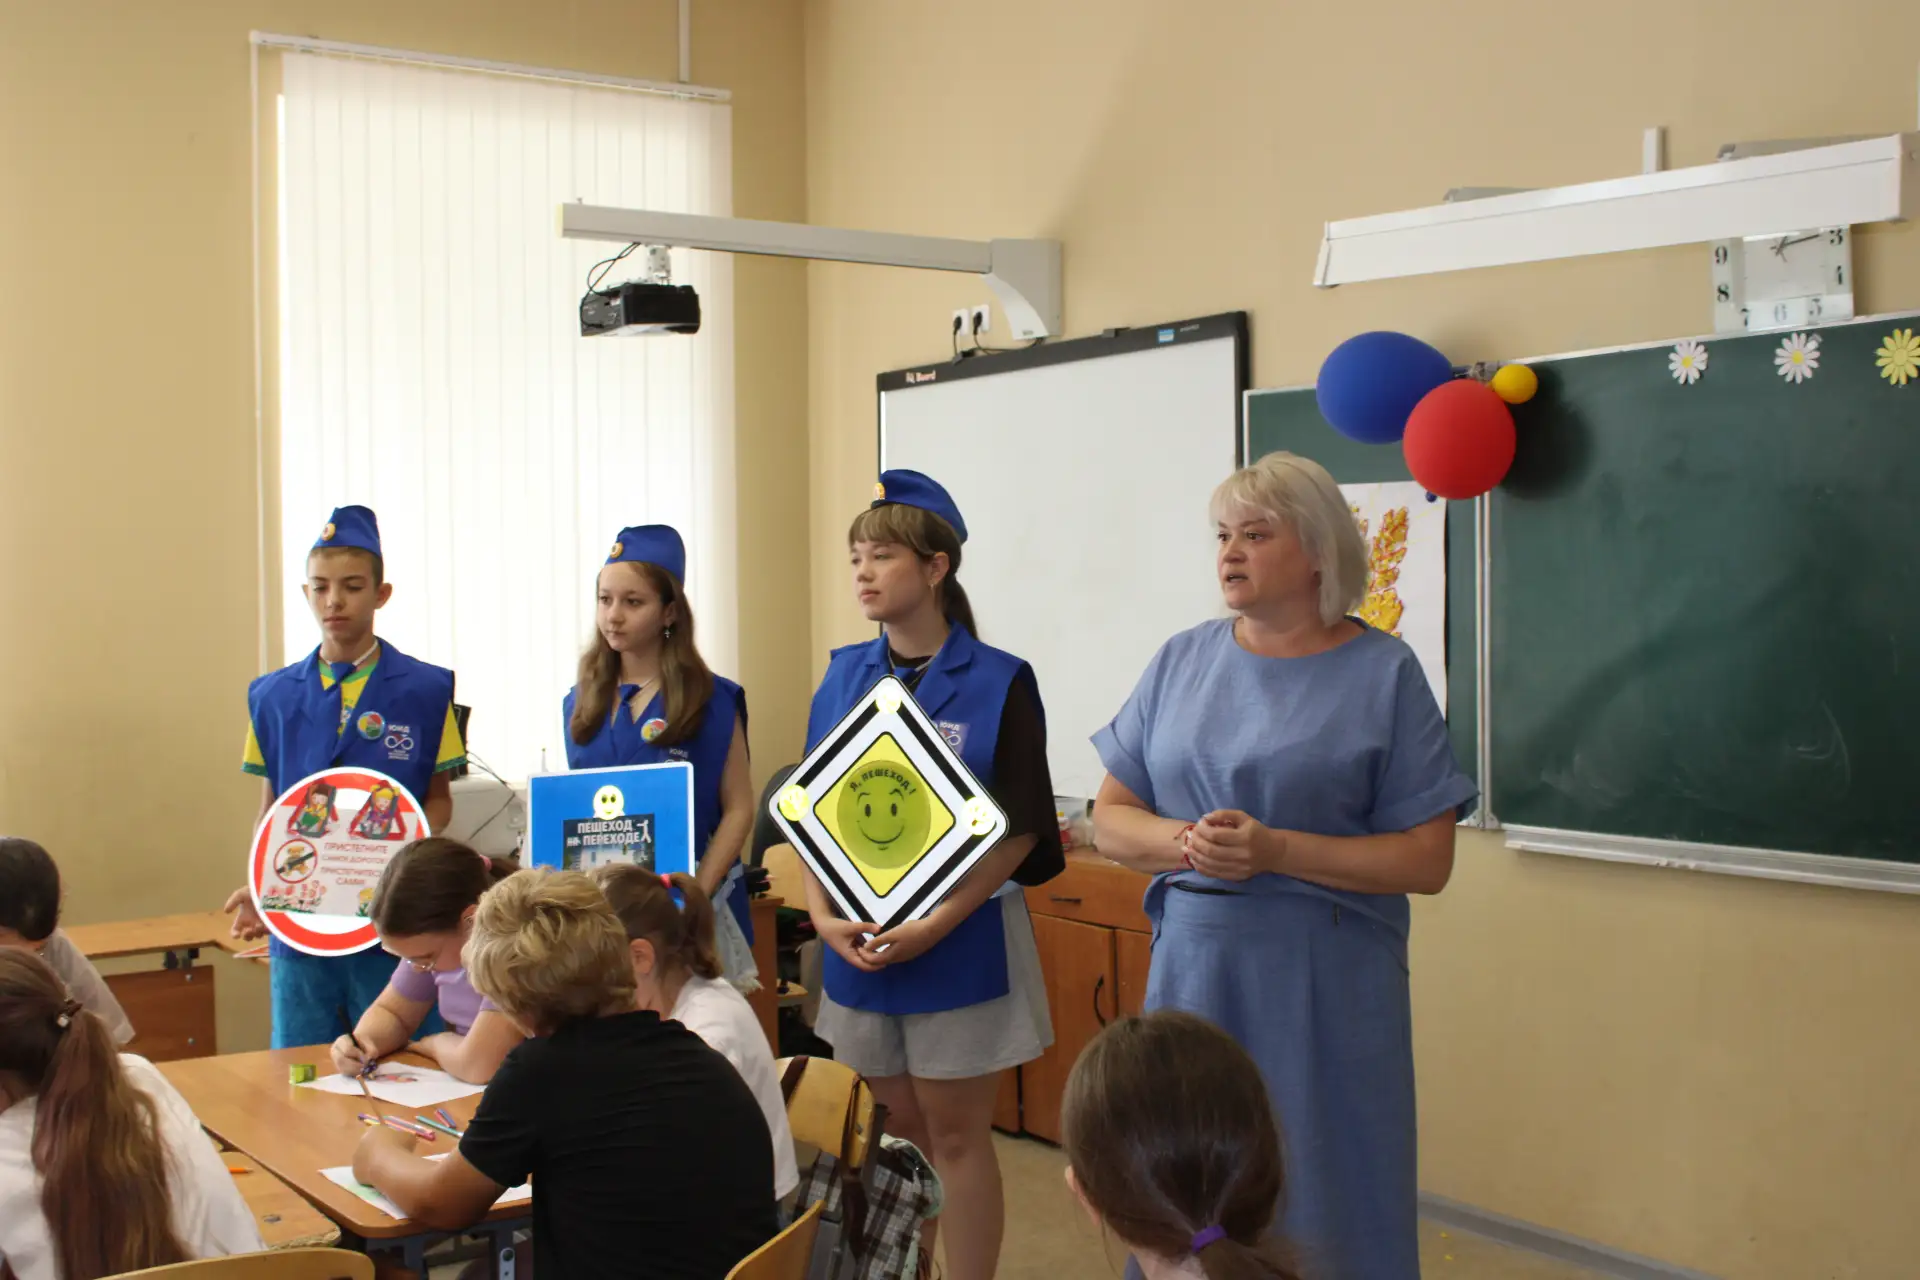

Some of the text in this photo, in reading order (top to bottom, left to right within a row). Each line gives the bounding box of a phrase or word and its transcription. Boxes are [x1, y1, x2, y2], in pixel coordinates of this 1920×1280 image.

[1830, 229, 1843, 245] 3
[1715, 246, 1728, 265] 9
[1717, 284, 1730, 302] 8
[1809, 298, 1822, 316] 5
[577, 819, 633, 834] ПЕШЕХОД
[583, 831, 640, 846] ПЕРЕХОДЕ
